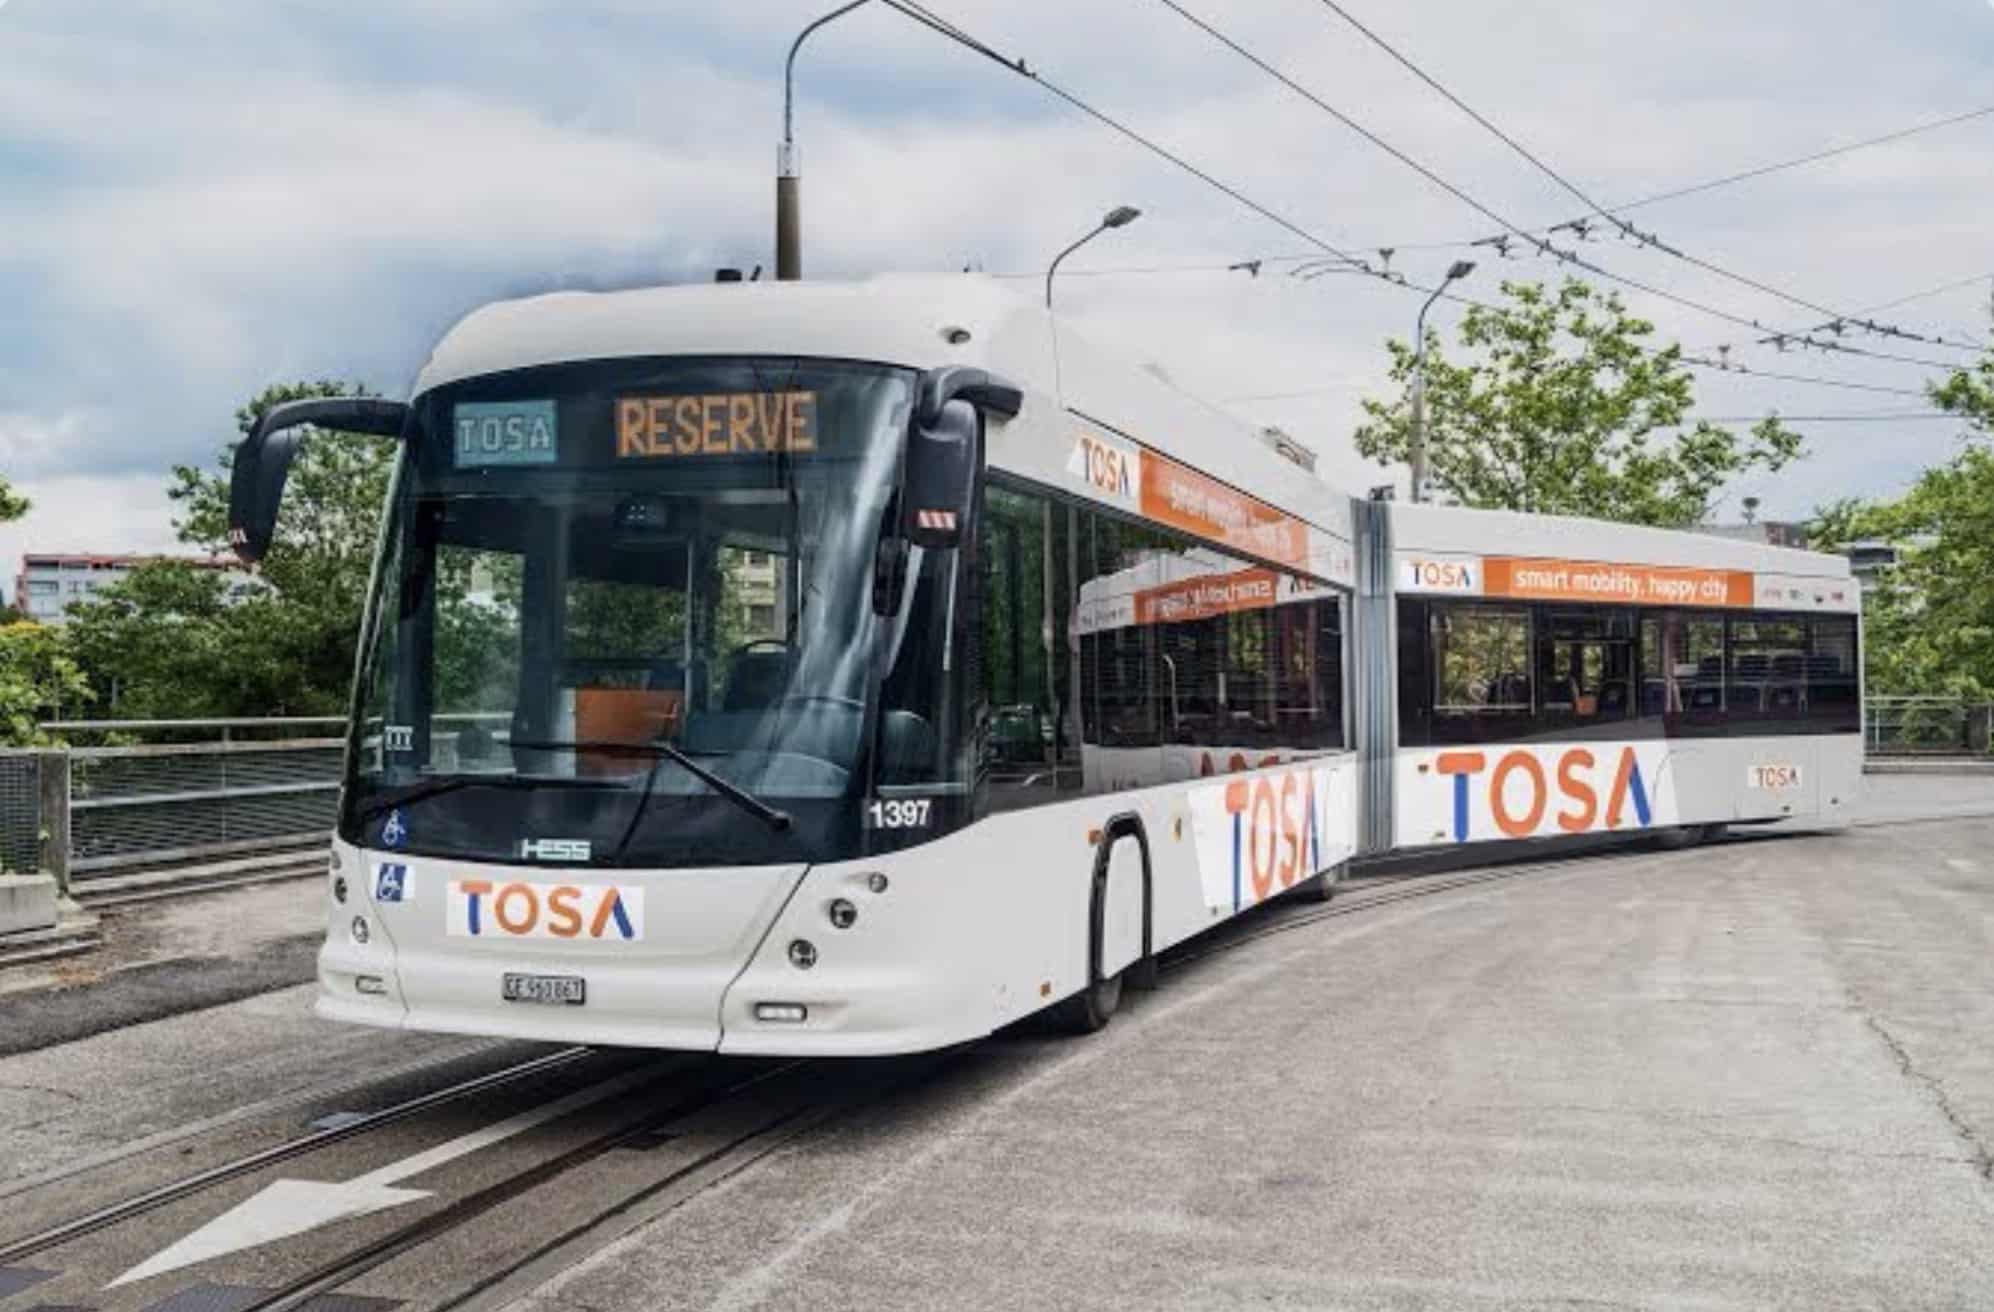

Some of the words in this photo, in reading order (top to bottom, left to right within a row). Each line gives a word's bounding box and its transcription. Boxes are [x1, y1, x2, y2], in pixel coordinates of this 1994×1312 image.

[459, 416, 550, 451] TOSA
[617, 391, 814, 456] RESERVE
[1081, 437, 1129, 496] TOSA
[1410, 562, 1470, 587] TOSA
[1515, 570, 1568, 590] smart
[1572, 570, 1645, 599] mobility,
[1650, 576, 1697, 604] happy
[1436, 745, 1652, 843] TOSA
[1756, 767, 1799, 786] TOSA
[870, 799, 930, 828] 1397
[521, 838, 592, 860] HESS
[1225, 766, 1319, 911] TOSA
[461, 881, 635, 938] TOSA
